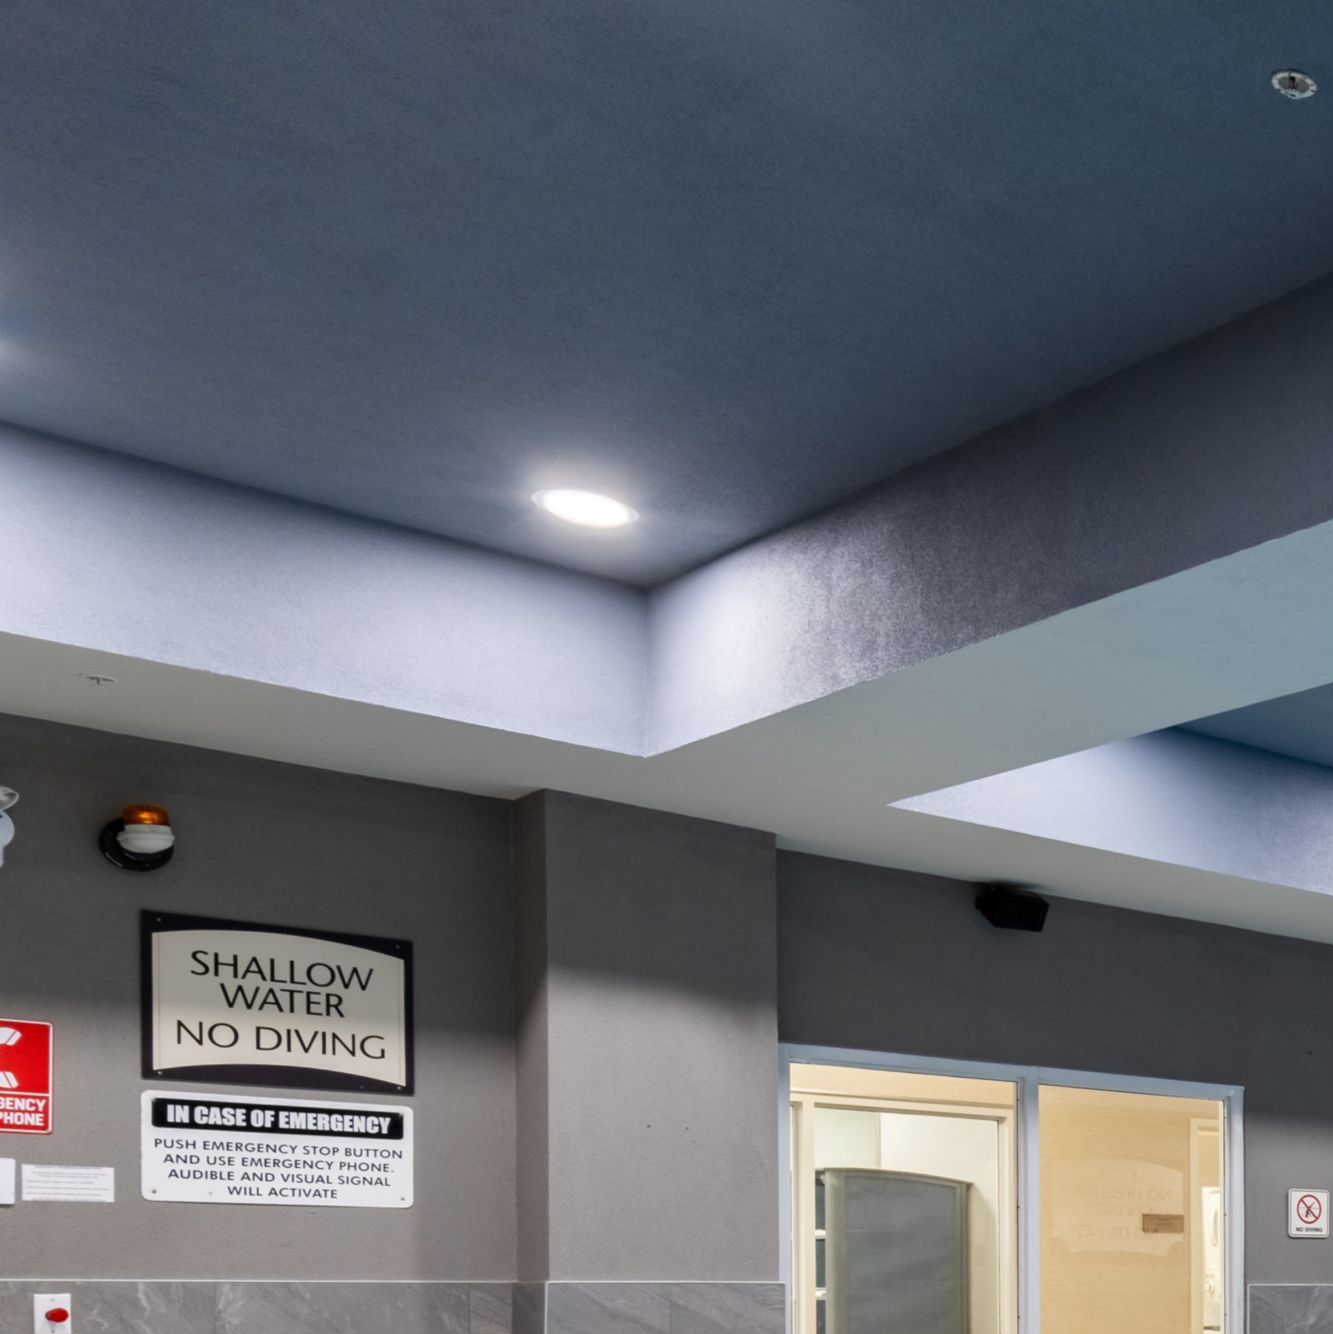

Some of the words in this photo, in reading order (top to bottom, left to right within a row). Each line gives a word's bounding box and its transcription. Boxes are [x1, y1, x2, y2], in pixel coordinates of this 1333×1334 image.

[190, 950, 373, 991] SHALLOW
[220, 983, 344, 1017] WATER
[177, 1020, 239, 1048] NO
[256, 1026, 385, 1059] DIVING
[167, 1104, 189, 1123] IN
[194, 1106, 246, 1126] CASE
[250, 1110, 276, 1128] OF
[279, 1111, 391, 1134] EMERGENCY
[155, 1139, 196, 1149] PUSH
[203, 1141, 298, 1154] EMERGENCY
[303, 1145, 339, 1156] STOP
[345, 1148, 402, 1159] BUTTON
[164, 1154, 200, 1164] AND
[207, 1156, 234, 1166] USE
[242, 1158, 333, 1170] EMERGENCY
[339, 1162, 394, 1173] PHONE.
[168, 1169, 234, 1181] AUDIBLE
[241, 1171, 275, 1182] AND
[281, 1173, 332, 1184] VISUAL
[338, 1176, 391, 1186] SIGNAL
[228, 1186, 263, 1196] WILL
[268, 1187, 338, 1198] ACTIVATE
